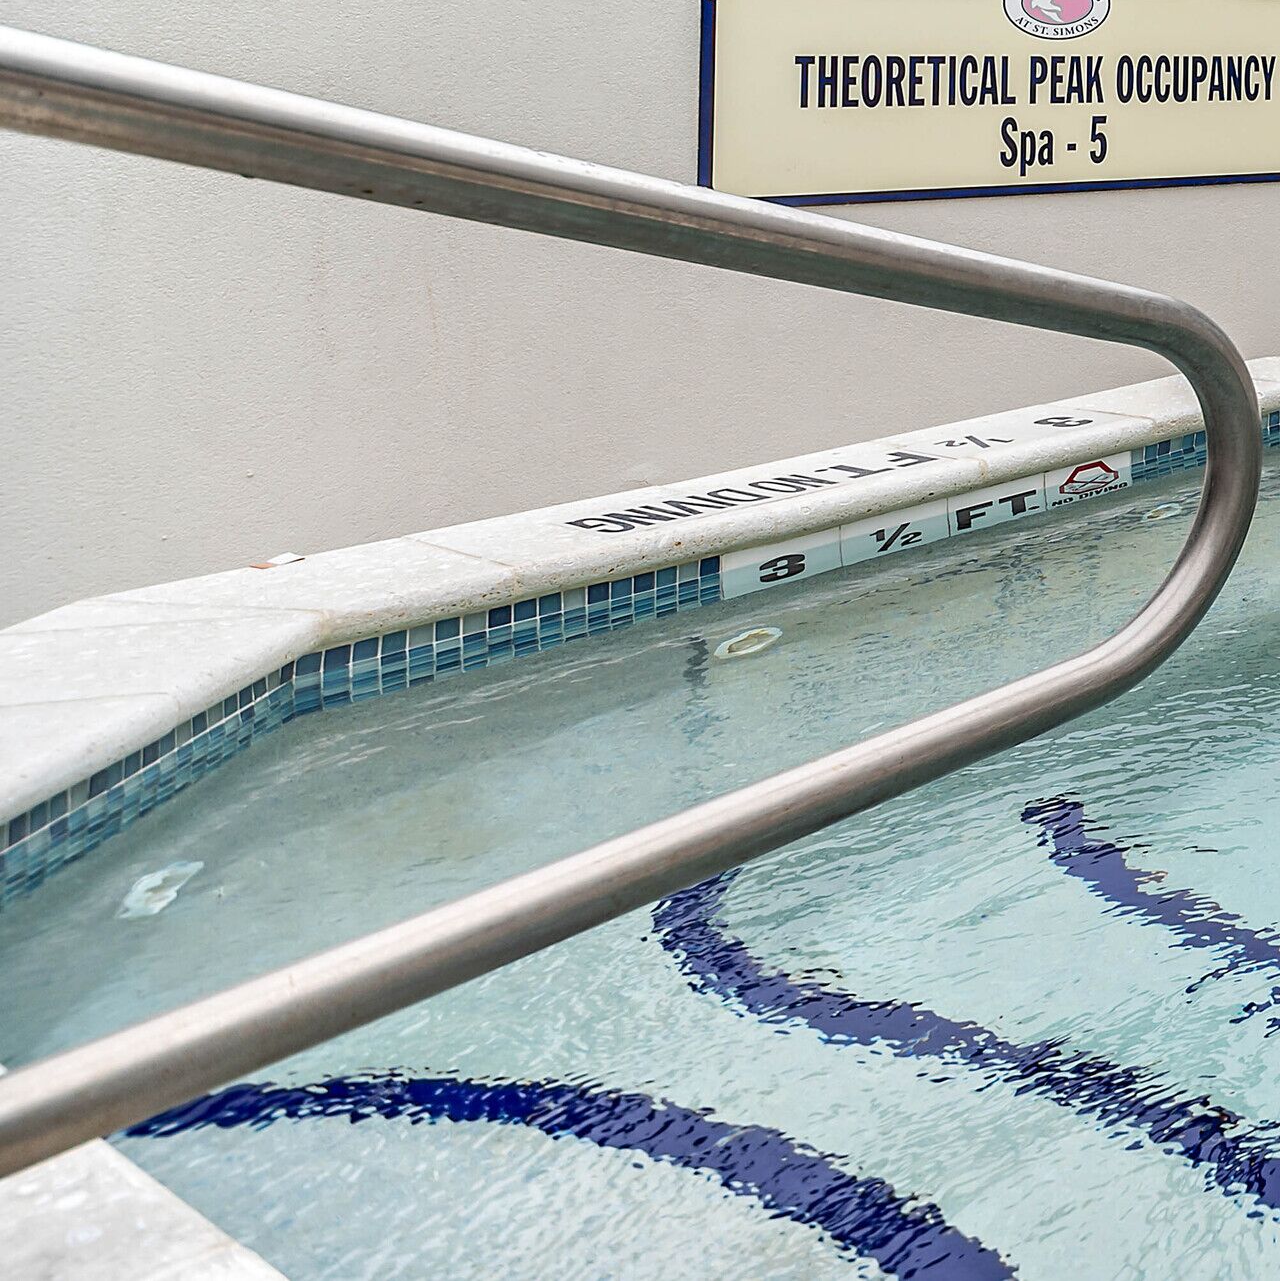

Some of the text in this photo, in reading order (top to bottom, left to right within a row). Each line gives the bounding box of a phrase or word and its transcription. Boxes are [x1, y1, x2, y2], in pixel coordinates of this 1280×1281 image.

[1015, 16, 1099, 36] AT ST. SIMONS
[794, 54, 1277, 109] THEORETICAL PEAK OCCUPANCY
[1000, 115, 1109, 177] Spa - 5
[1034, 416, 1094, 428] 3
[748, 474, 839, 493] NO
[1052, 482, 1128, 507] NO DIVING
[565, 488, 772, 533] DIVING
[760, 553, 805, 583] 3
[956, 488, 1041, 530] FT.
